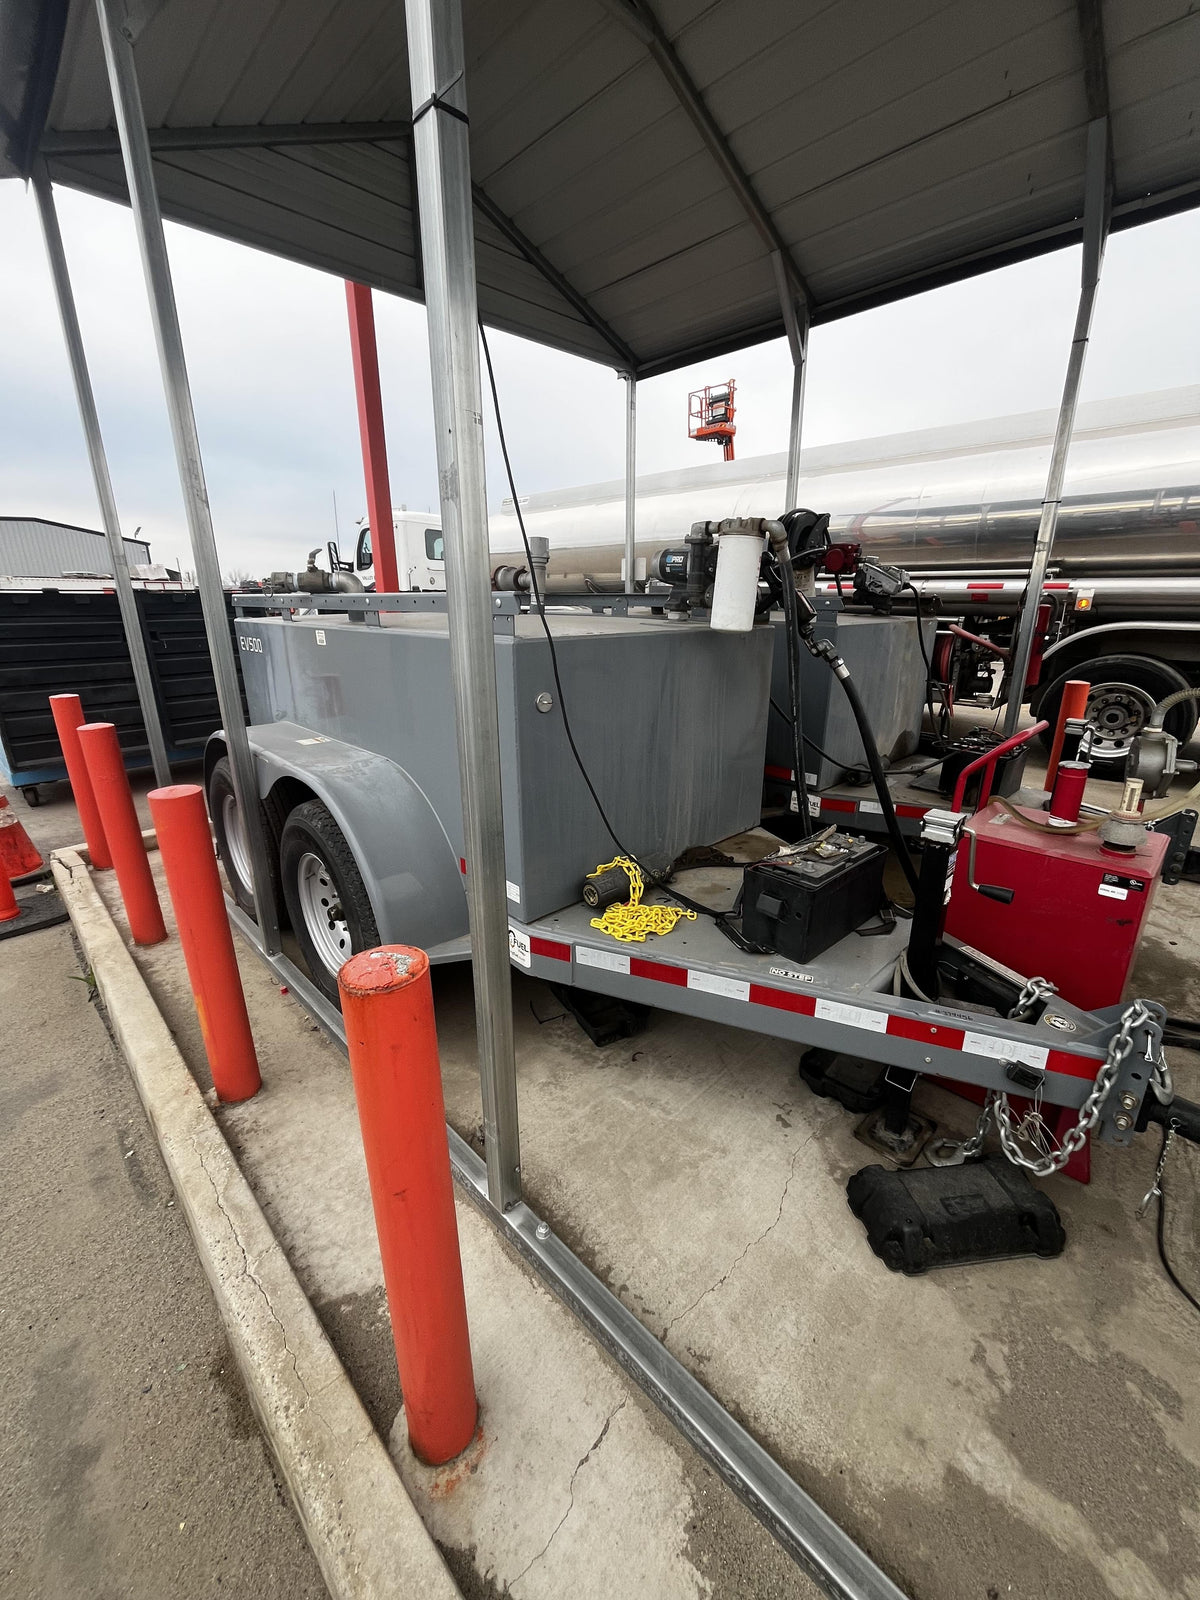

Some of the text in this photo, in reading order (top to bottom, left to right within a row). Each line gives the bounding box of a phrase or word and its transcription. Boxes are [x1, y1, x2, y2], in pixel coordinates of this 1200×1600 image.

[240, 636, 263, 653] EV500
[513, 938, 529, 953] FUEL
[771, 968, 812, 982] NO STEP
